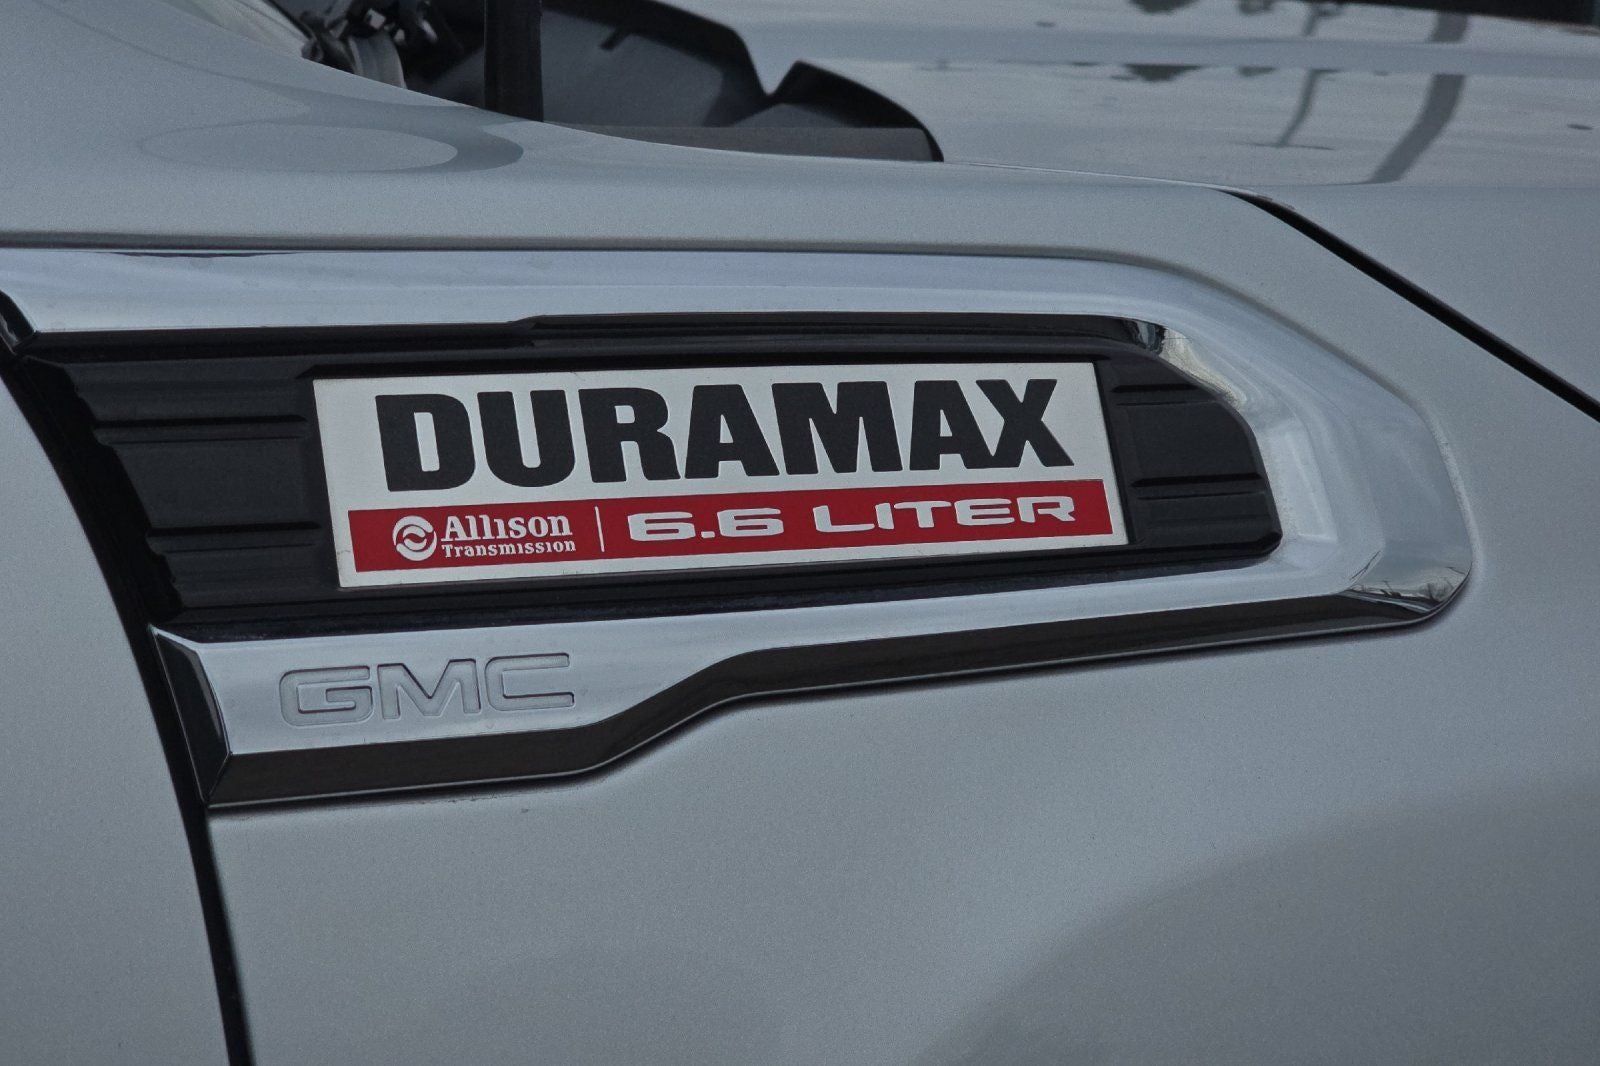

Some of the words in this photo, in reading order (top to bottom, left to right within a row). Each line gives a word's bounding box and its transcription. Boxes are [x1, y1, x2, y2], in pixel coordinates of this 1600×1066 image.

[375, 378, 1075, 492] DURAMAX
[441, 514, 573, 542] Allison
[627, 507, 784, 542] 6.6
[813, 496, 1076, 533] LITER
[441, 539, 577, 559] Transmission
[279, 652, 575, 727] GMC
